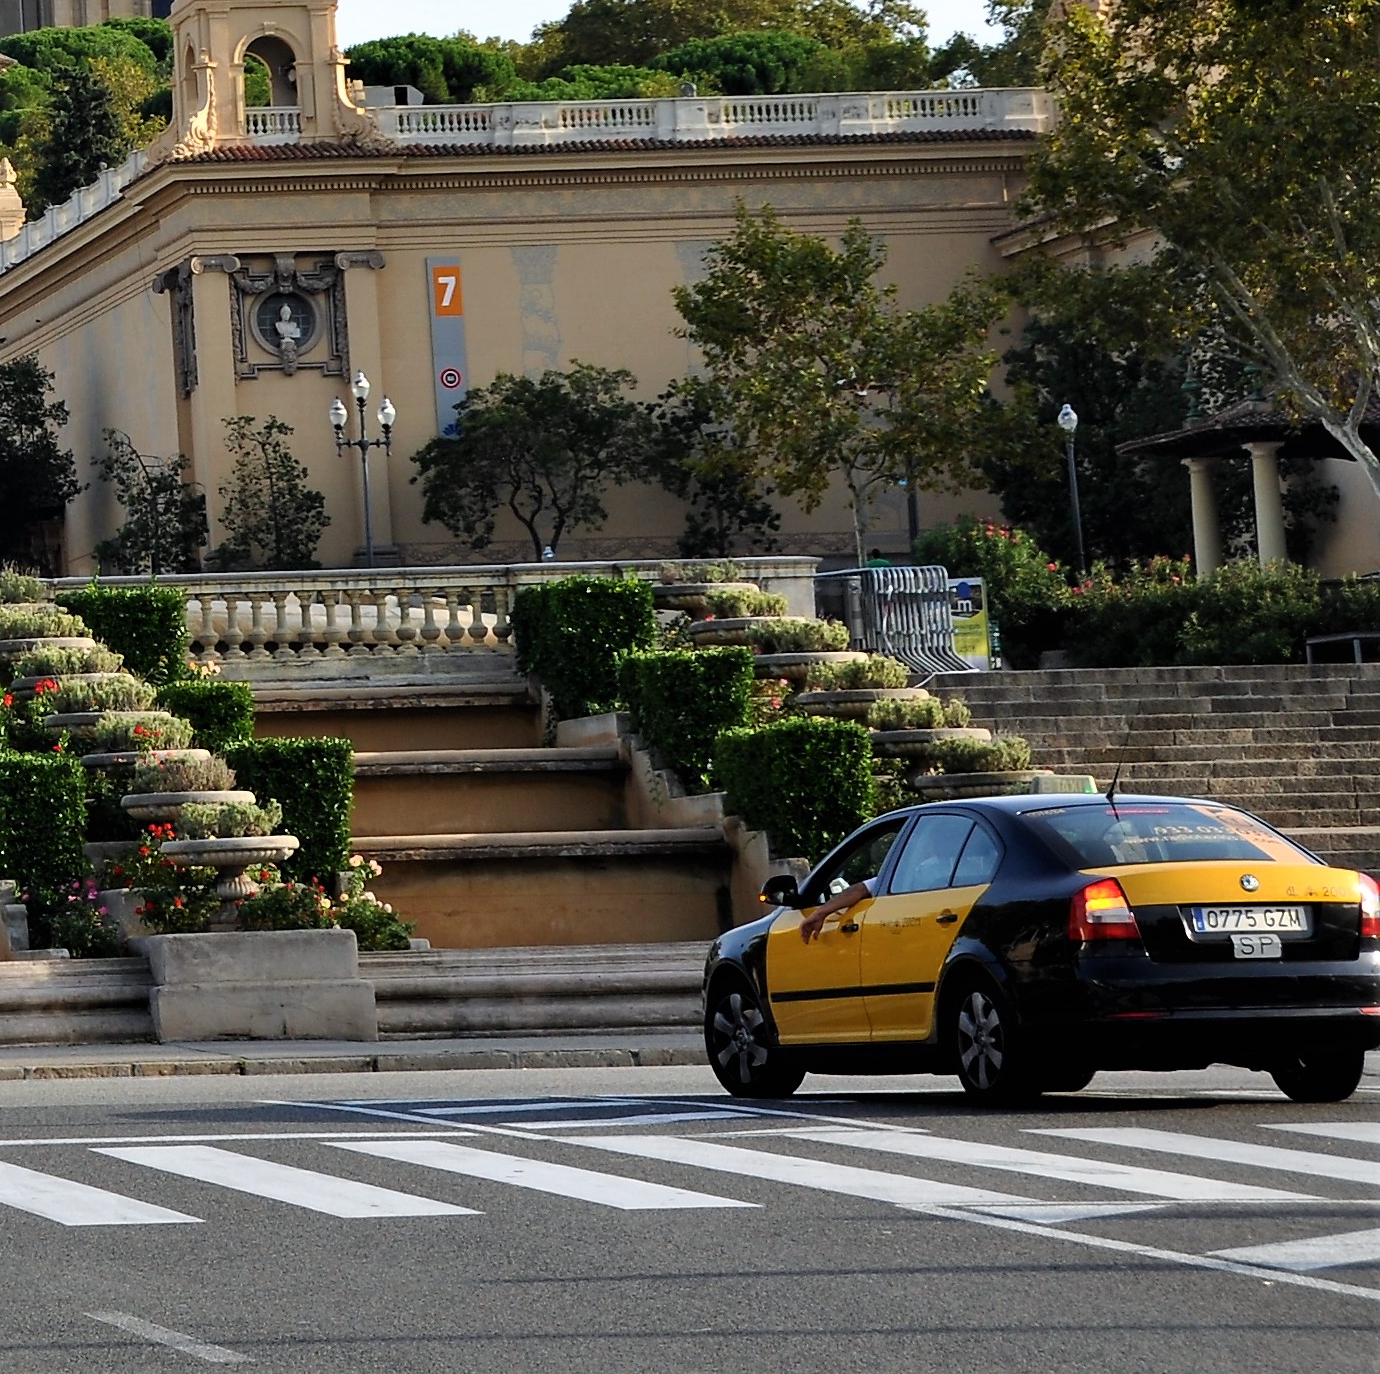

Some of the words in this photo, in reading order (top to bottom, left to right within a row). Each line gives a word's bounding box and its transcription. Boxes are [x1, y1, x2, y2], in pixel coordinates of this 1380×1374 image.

[437, 275, 457, 307] 7
[1206, 909, 1257, 929] 0775
[1263, 908, 1302, 928] GZM
[1240, 936, 1274, 956] SP
